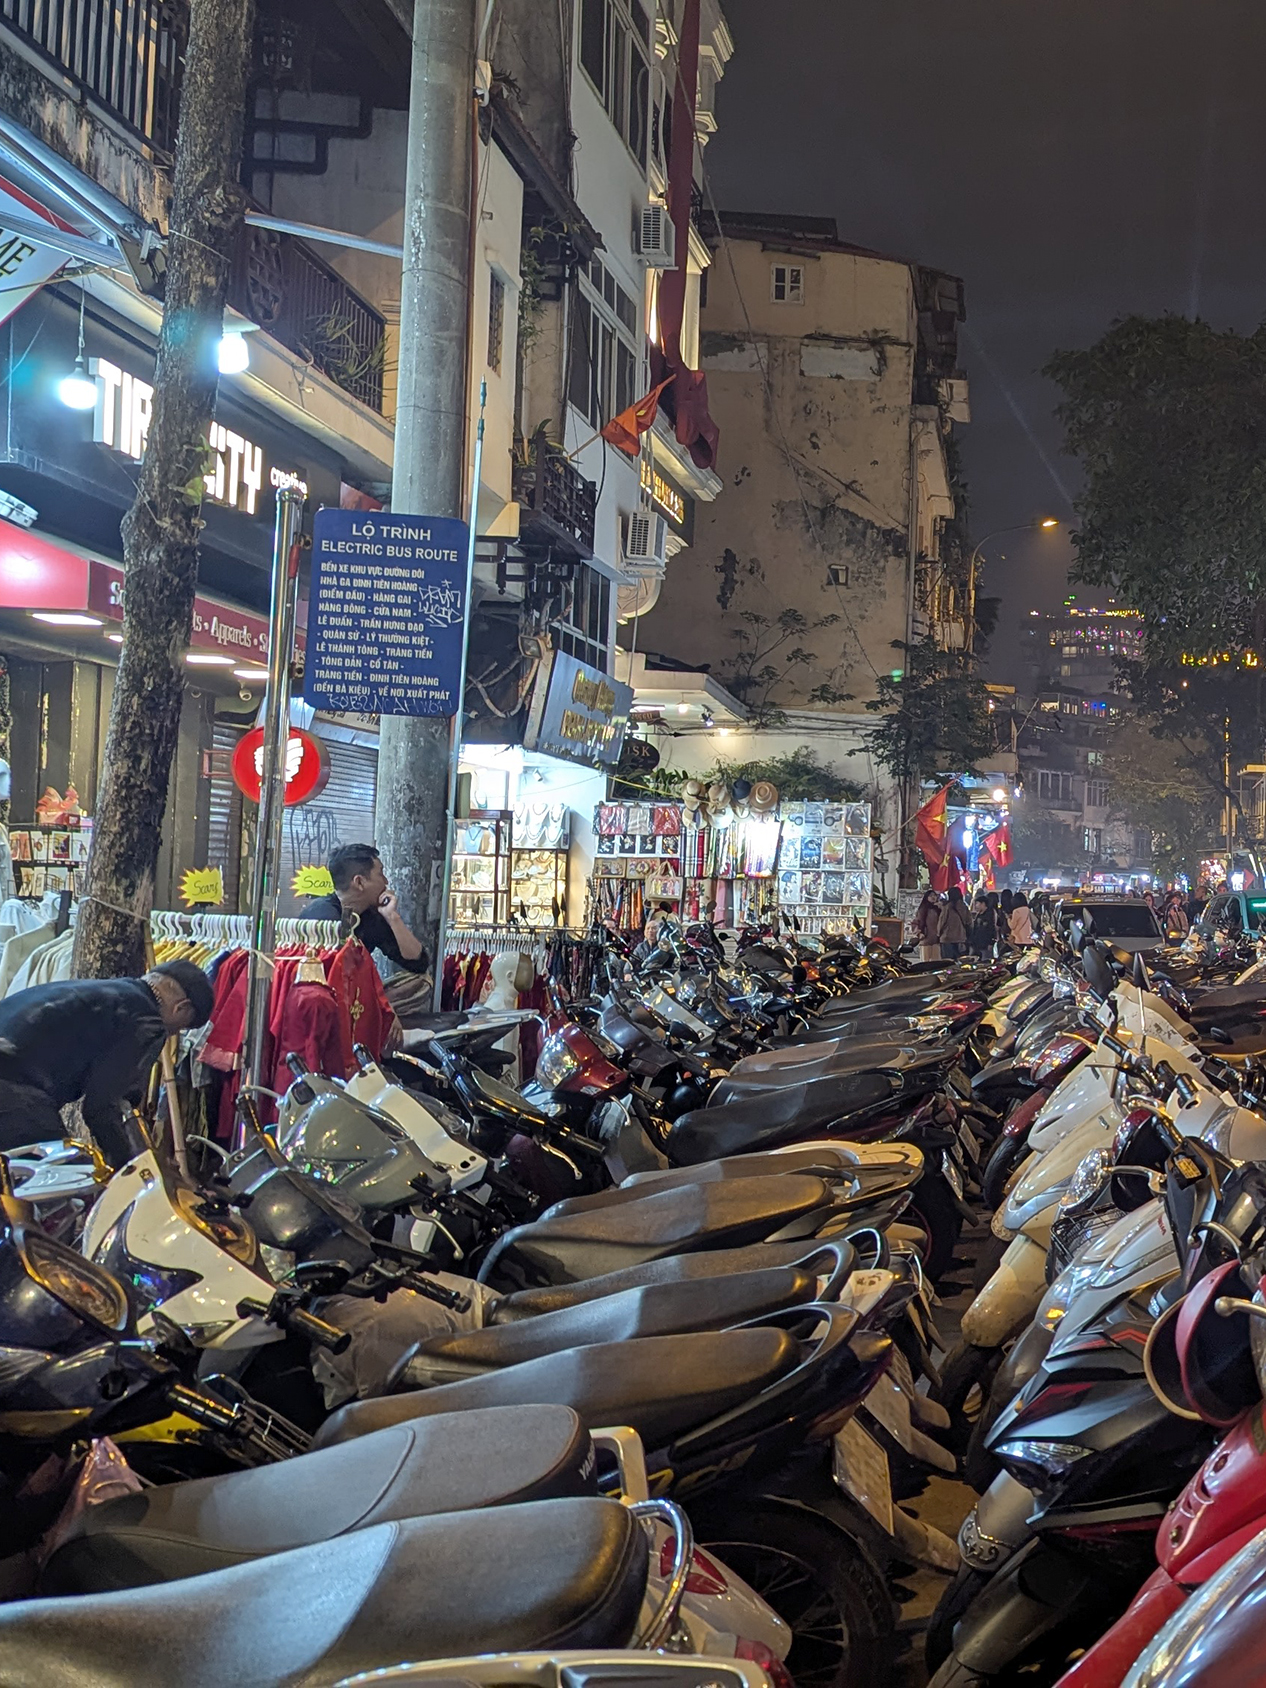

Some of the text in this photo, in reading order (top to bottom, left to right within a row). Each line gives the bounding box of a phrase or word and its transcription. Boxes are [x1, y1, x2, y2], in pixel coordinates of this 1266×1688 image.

[352, 521, 431, 541] LỘ TRÌNH
[322, 540, 457, 561] ELECTRIC BUS ROUTE
[321, 560, 337, 572] BẾN
[339, 564, 348, 572] XE
[350, 565, 366, 574] KHU
[320, 575, 338, 586] NHÀ
[340, 577, 350, 586] GA
[391, 580, 417, 591] HOÀNG
[373, 591, 395, 603] HÀNG
[397, 595, 411, 604] GAI
[319, 602, 341, 612] HÀNG
[344, 604, 366, 615] BÔNG
[392, 608, 411, 618] NAM
[318, 616, 327, 625] LÊ
[211, 616, 252, 648] Apparels
[316, 642, 326, 652] LÊ
[357, 645, 379, 656] TÔNG
[335, 683, 346, 693] BÀ
[411, 676, 439, 687] HOÀNG
